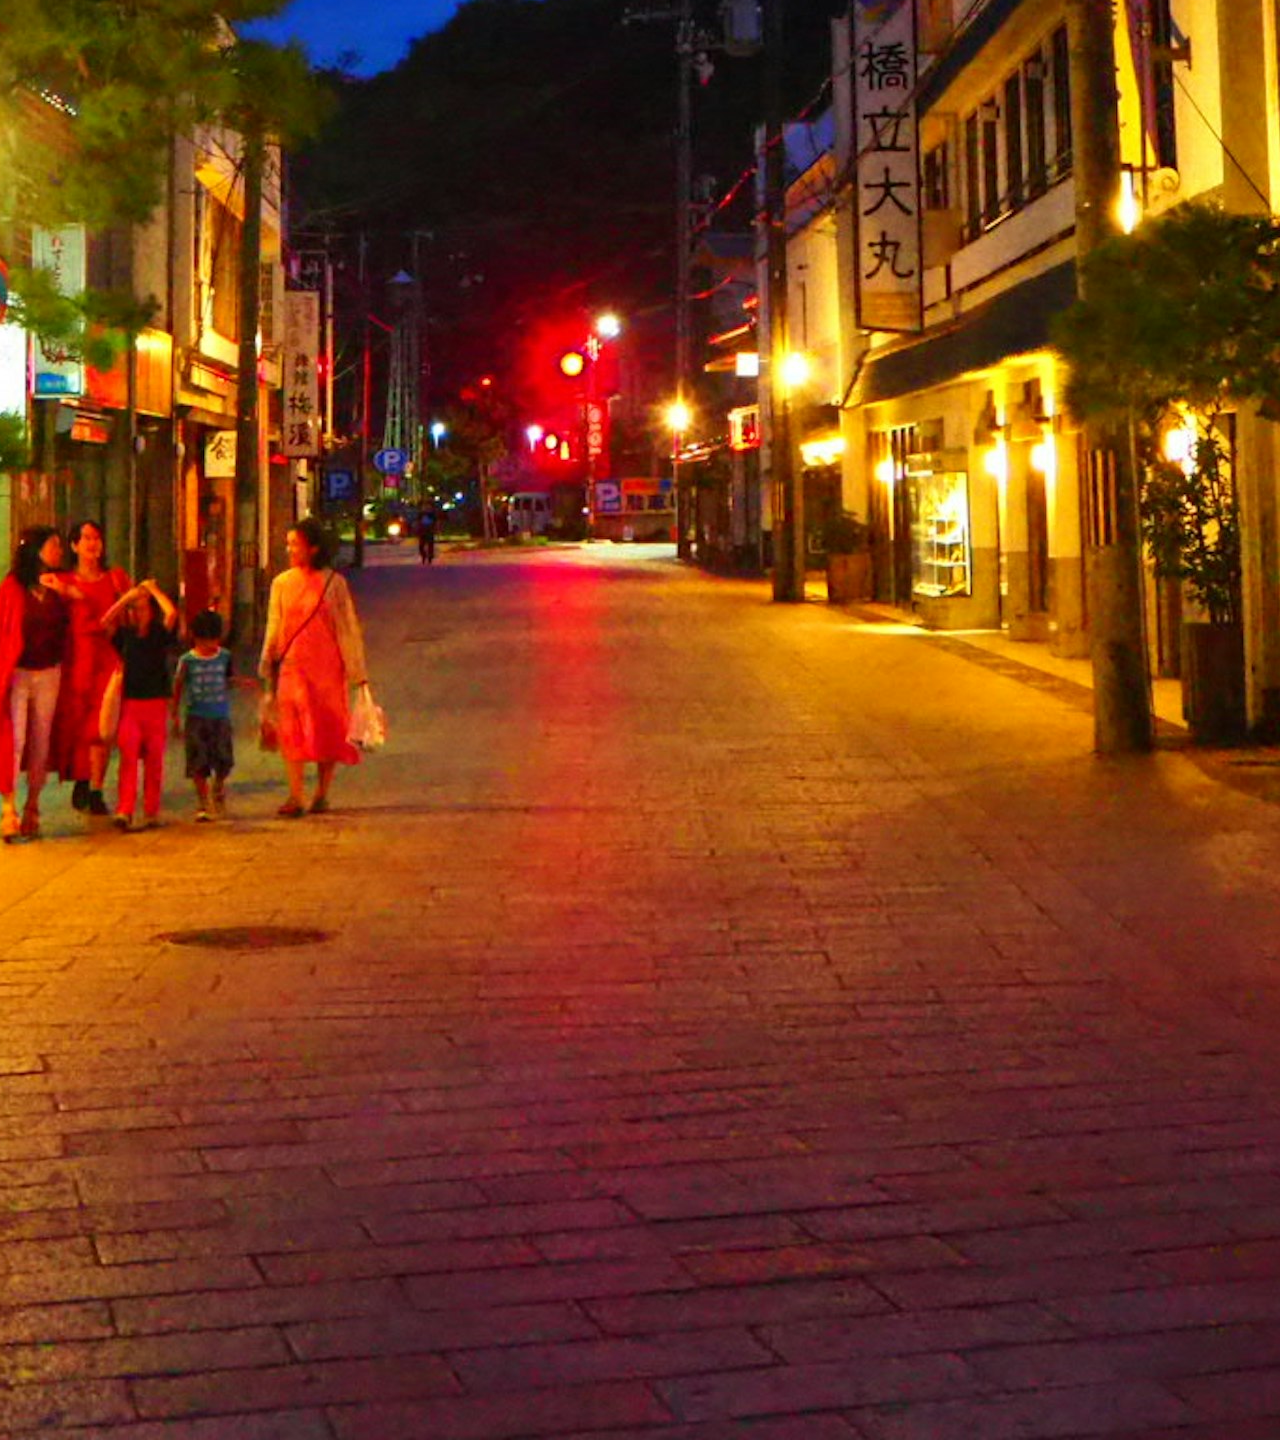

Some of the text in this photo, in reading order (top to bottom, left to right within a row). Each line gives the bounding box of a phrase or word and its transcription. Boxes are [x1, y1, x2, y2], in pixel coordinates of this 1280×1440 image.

[860, 43, 916, 280] 橋立大丸
[384, 451, 401, 470] P
[329, 473, 350, 498] P
